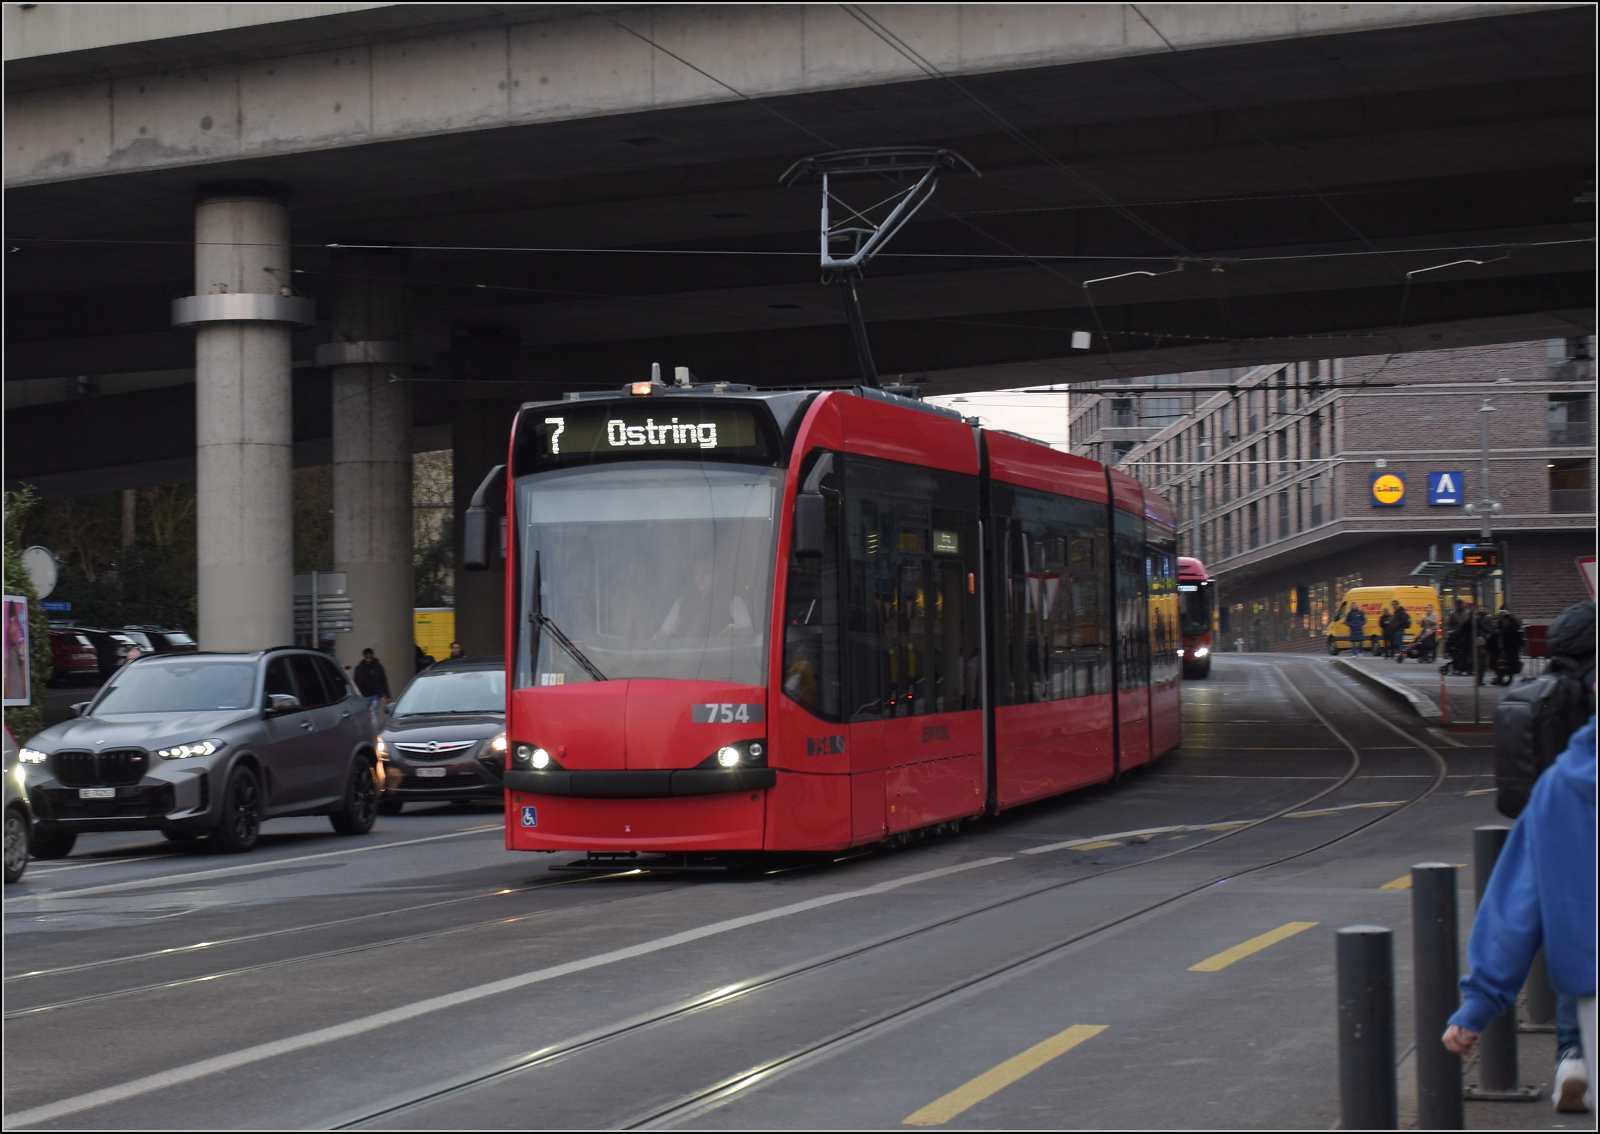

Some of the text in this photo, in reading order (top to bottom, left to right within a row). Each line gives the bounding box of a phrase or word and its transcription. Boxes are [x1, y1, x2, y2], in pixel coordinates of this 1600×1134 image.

[544, 417, 718, 455] 7 Ostring
[705, 703, 750, 724] 754
